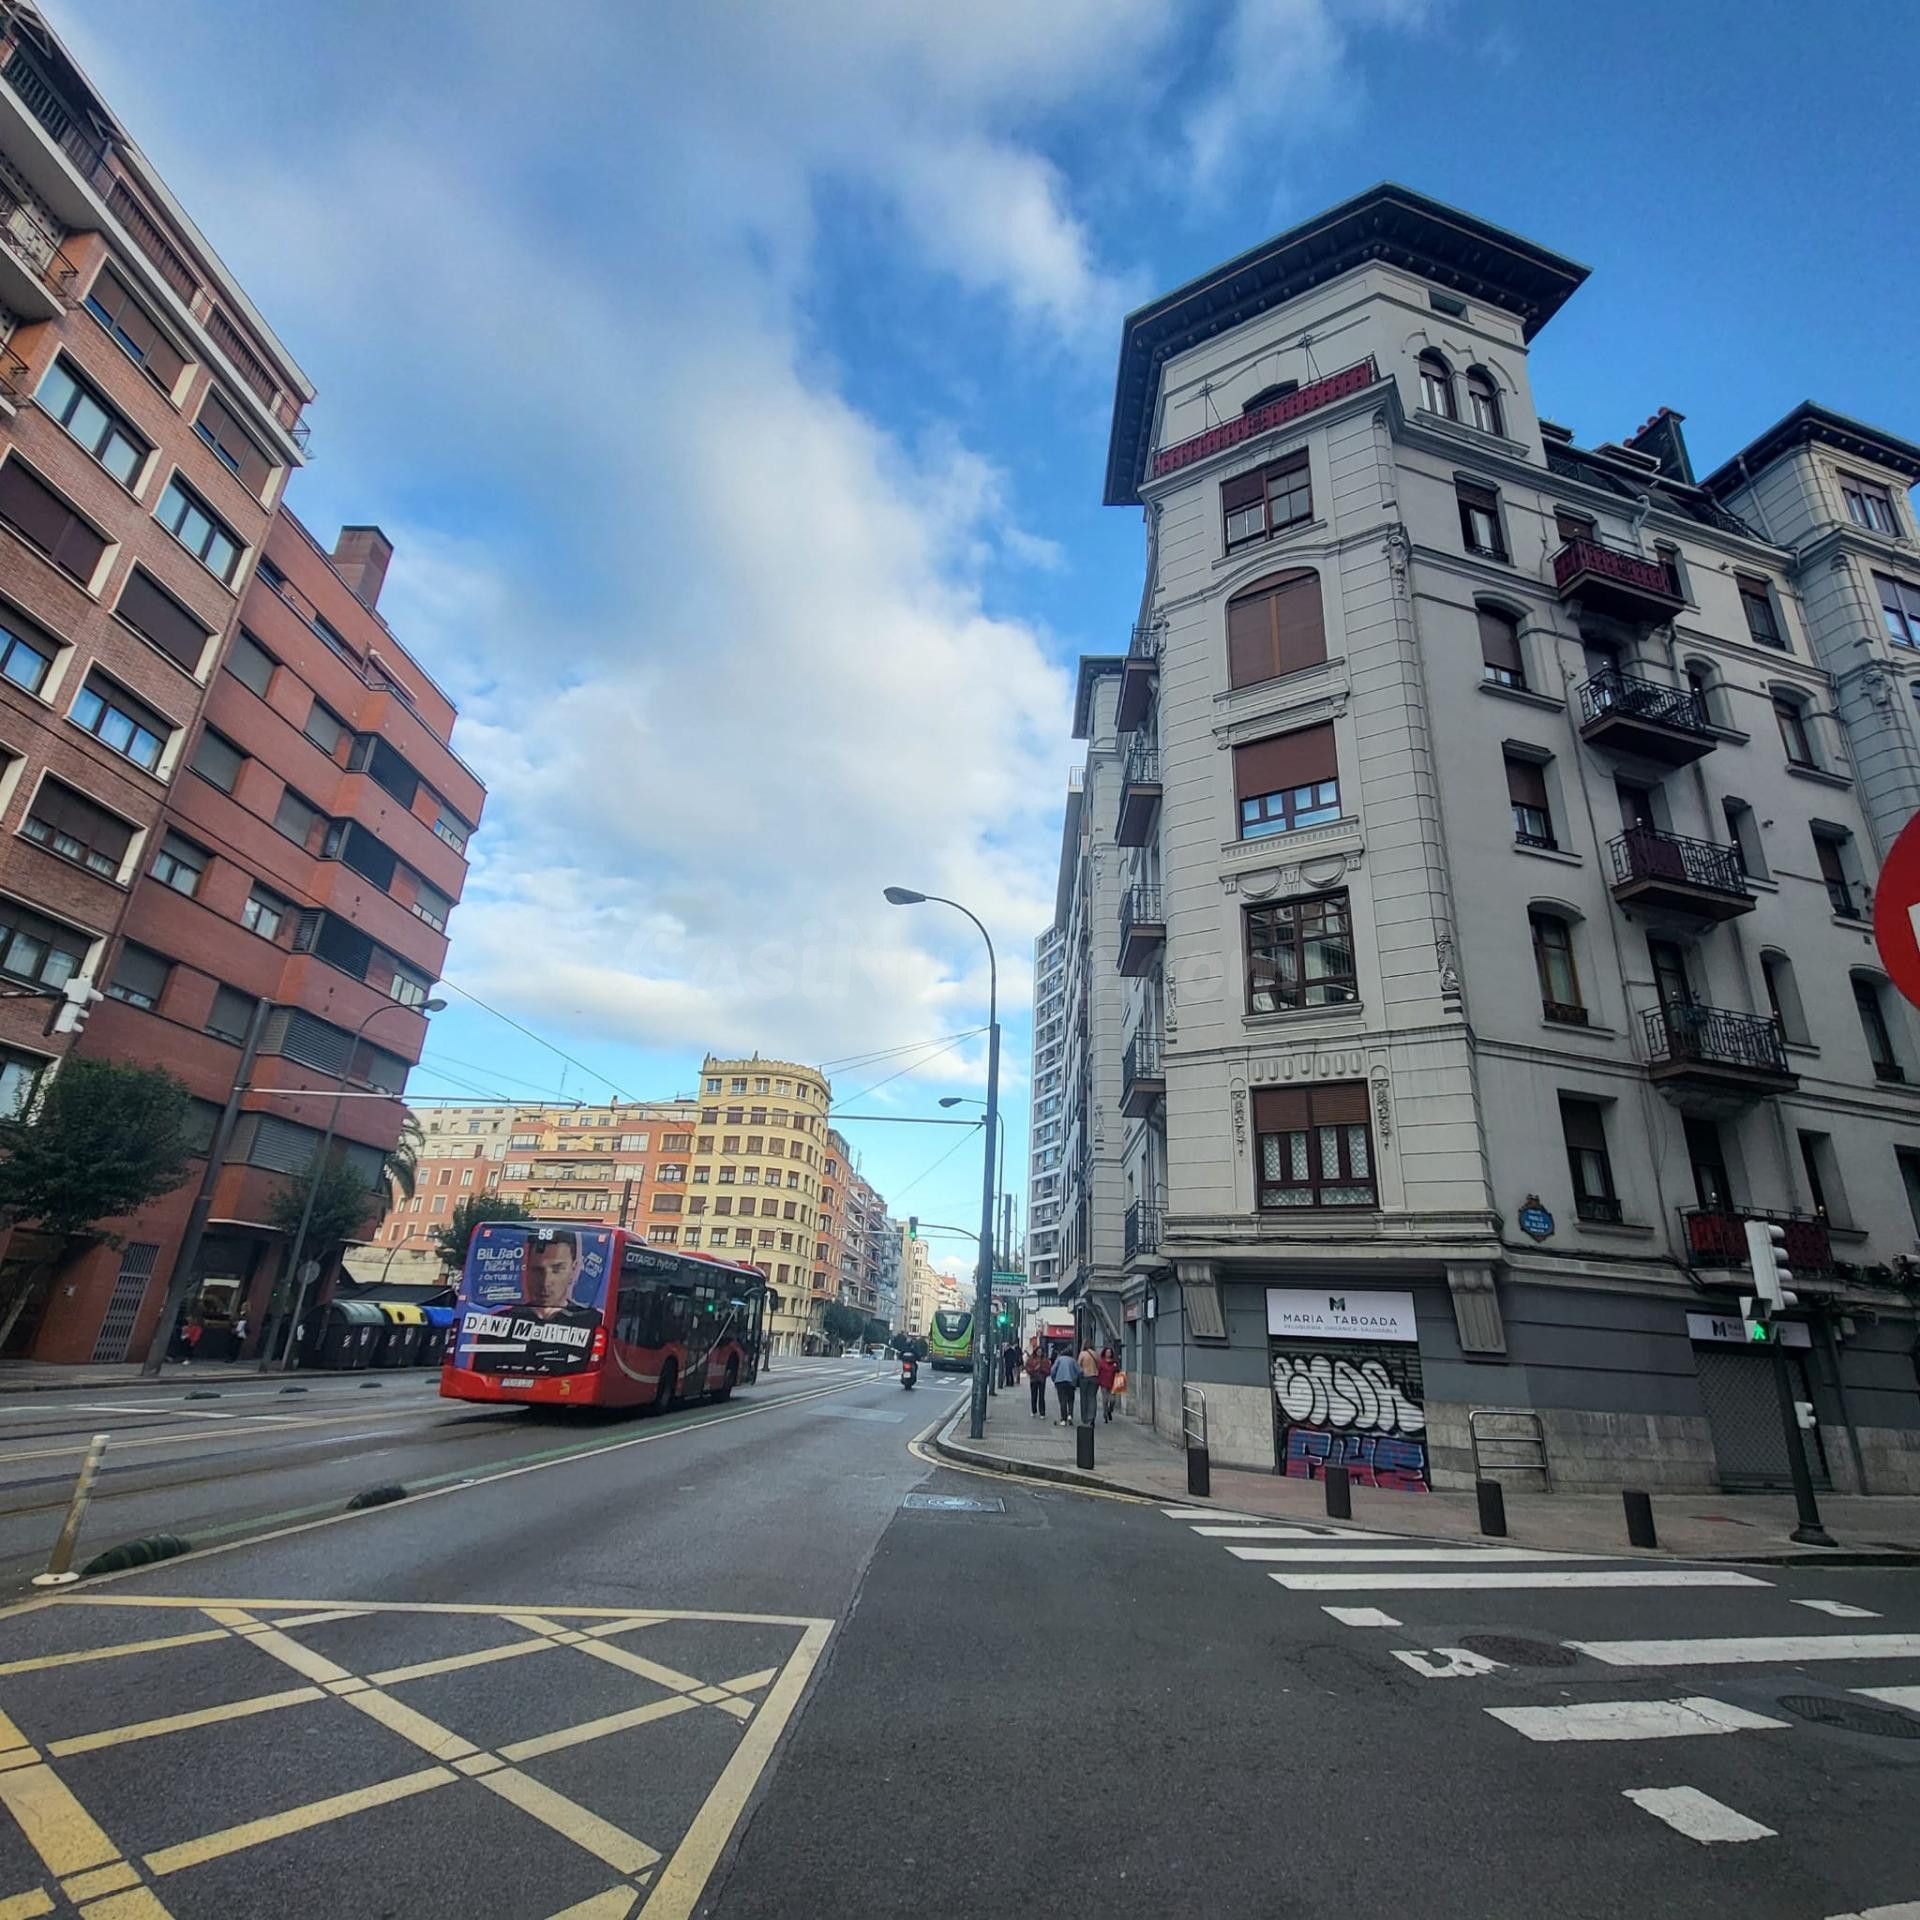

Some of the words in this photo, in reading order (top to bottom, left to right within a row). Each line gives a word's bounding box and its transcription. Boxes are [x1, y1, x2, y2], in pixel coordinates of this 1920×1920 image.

[538, 1229, 554, 1240] 58
[625, 1252, 656, 1266] CITARO
[1283, 1314, 1324, 1324] MARIA
[1333, 1315, 1398, 1327] TABOADA
